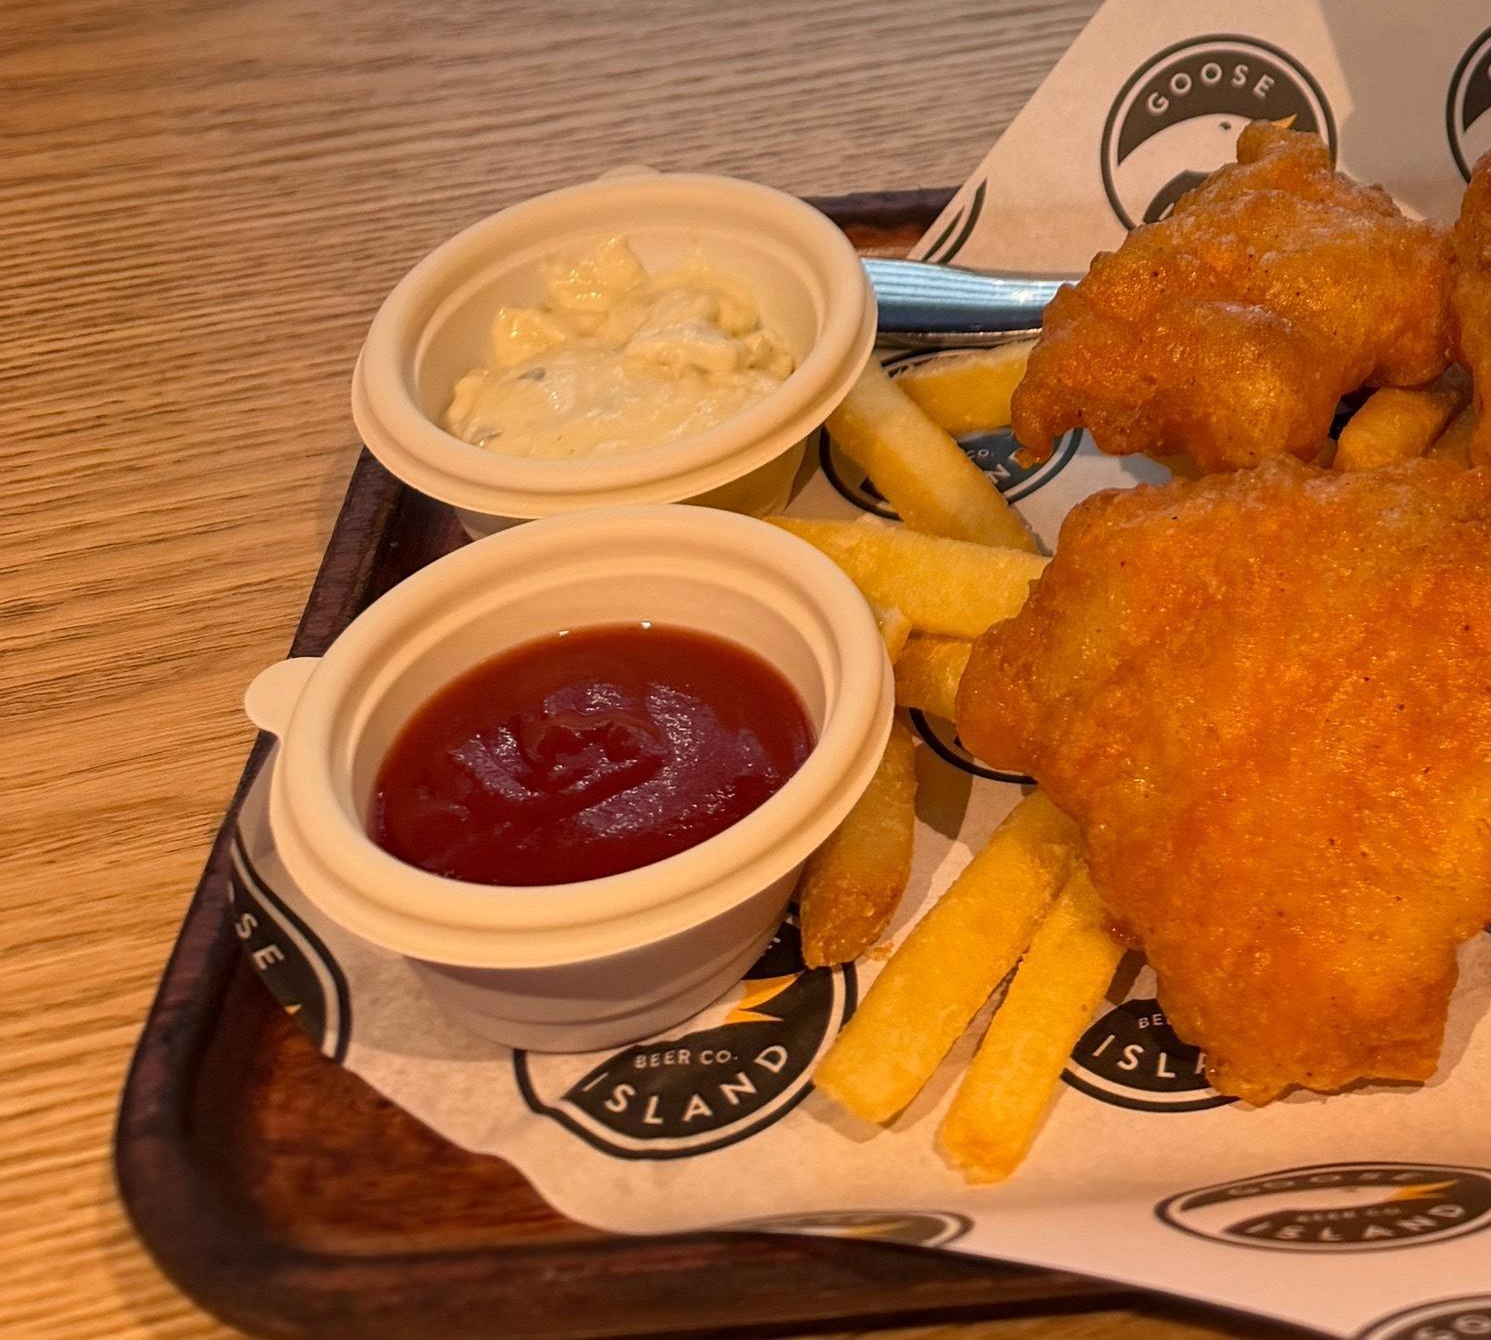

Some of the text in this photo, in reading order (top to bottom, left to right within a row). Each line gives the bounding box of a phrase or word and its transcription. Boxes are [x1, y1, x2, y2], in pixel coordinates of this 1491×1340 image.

[1146, 62, 1276, 115] GOOSE
[634, 1049, 691, 1069] BEER
[1092, 1034, 1208, 1079] ISL
[582, 1045, 788, 1126] ISLAND
[1246, 1205, 1466, 1241] ISLAND
